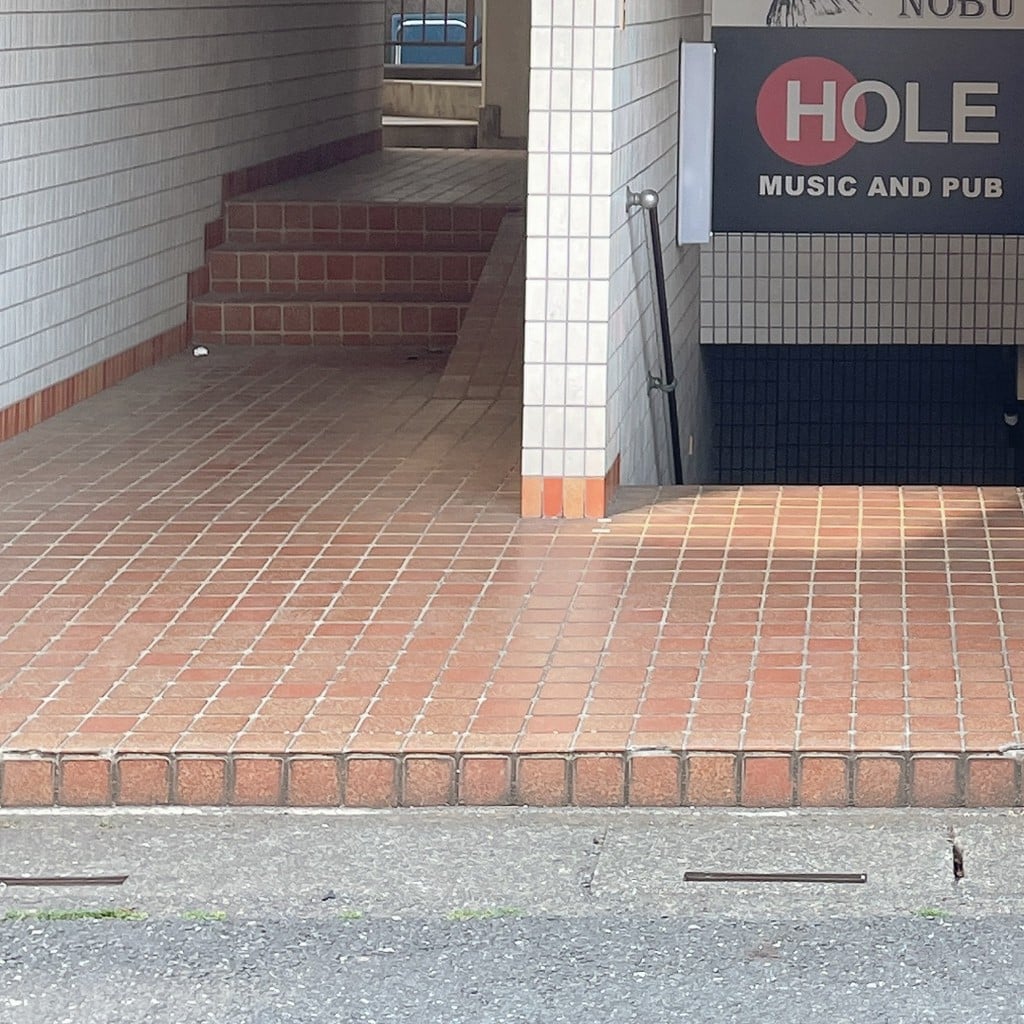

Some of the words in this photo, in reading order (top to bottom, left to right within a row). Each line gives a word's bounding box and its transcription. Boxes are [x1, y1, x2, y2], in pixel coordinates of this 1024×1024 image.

[786, 80, 999, 143] HOLE
[759, 175, 858, 197] MUSIC
[867, 177, 931, 198] AND
[942, 178, 1003, 199] PUB
